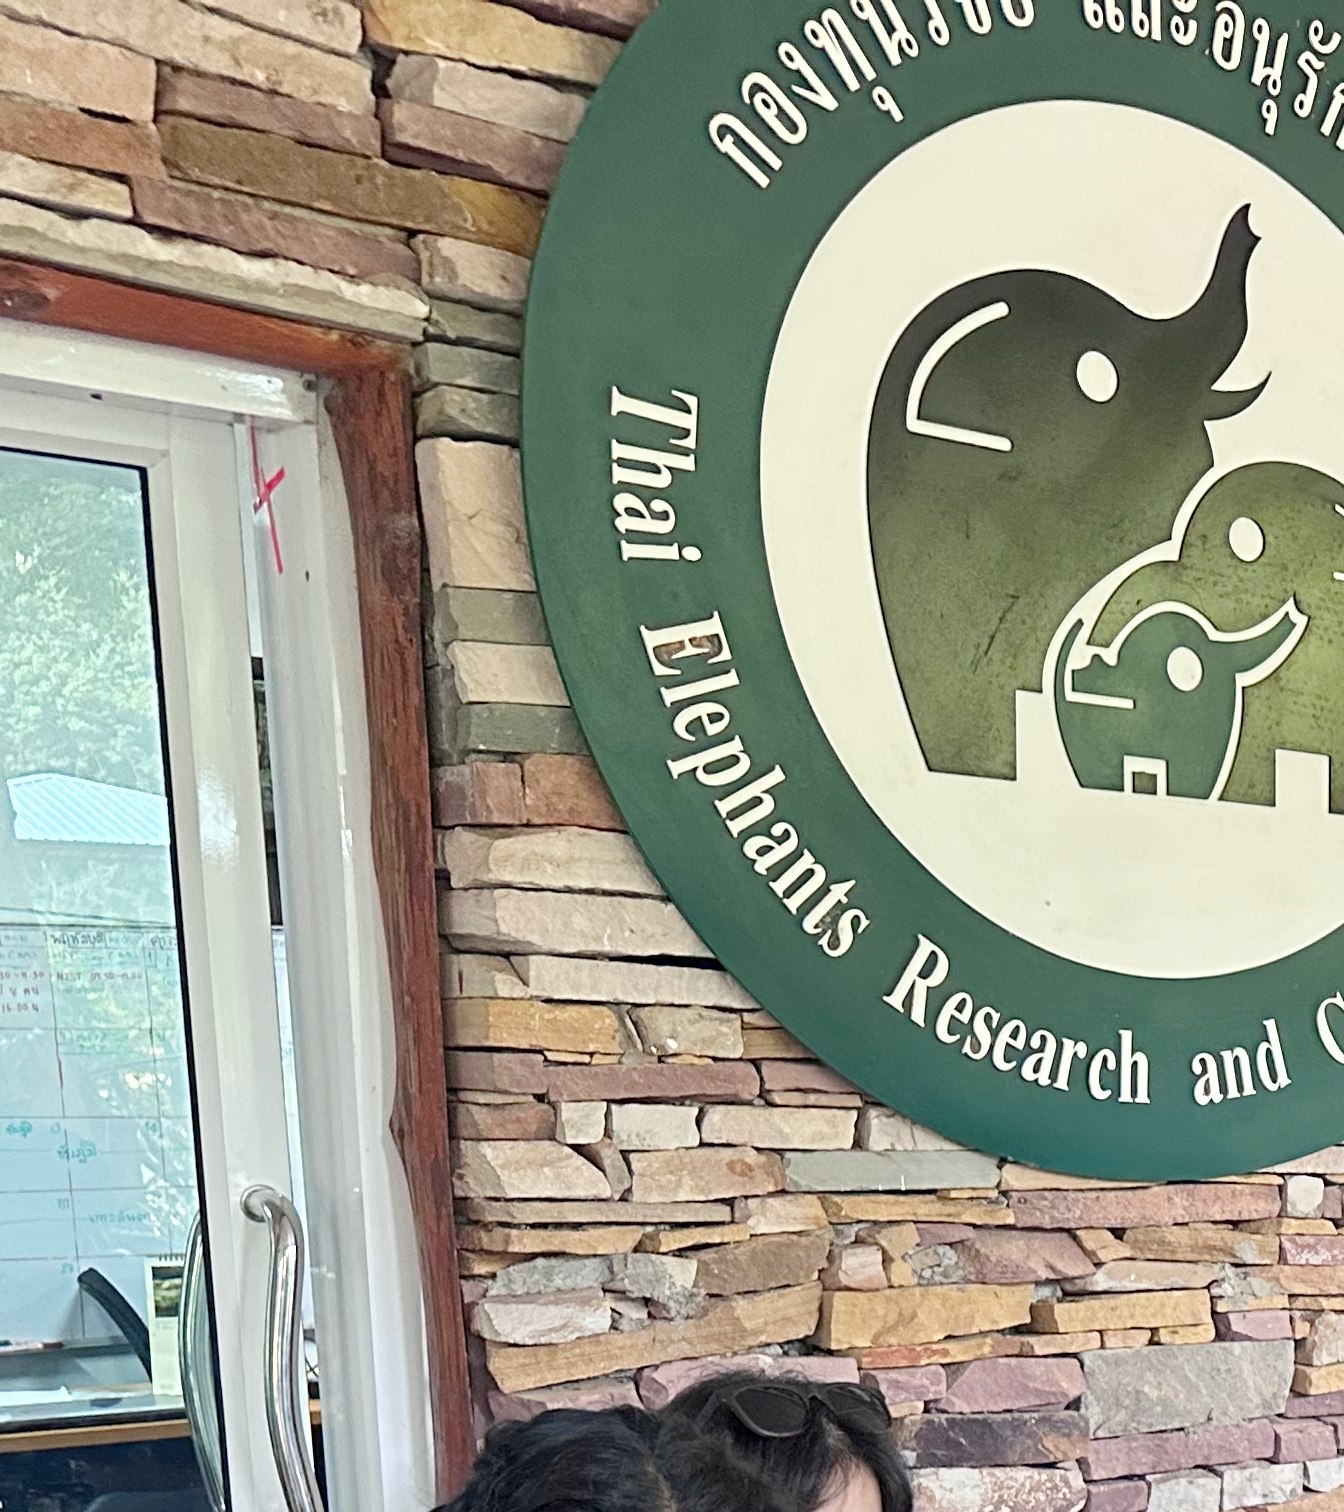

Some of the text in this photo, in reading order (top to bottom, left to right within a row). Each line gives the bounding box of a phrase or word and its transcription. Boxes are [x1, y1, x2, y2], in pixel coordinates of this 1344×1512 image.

[607, 382, 700, 565] Thai
[638, 611, 870, 958] Elephants
[884, 934, 1151, 1104] Research
[1191, 1022, 1292, 1106] and
